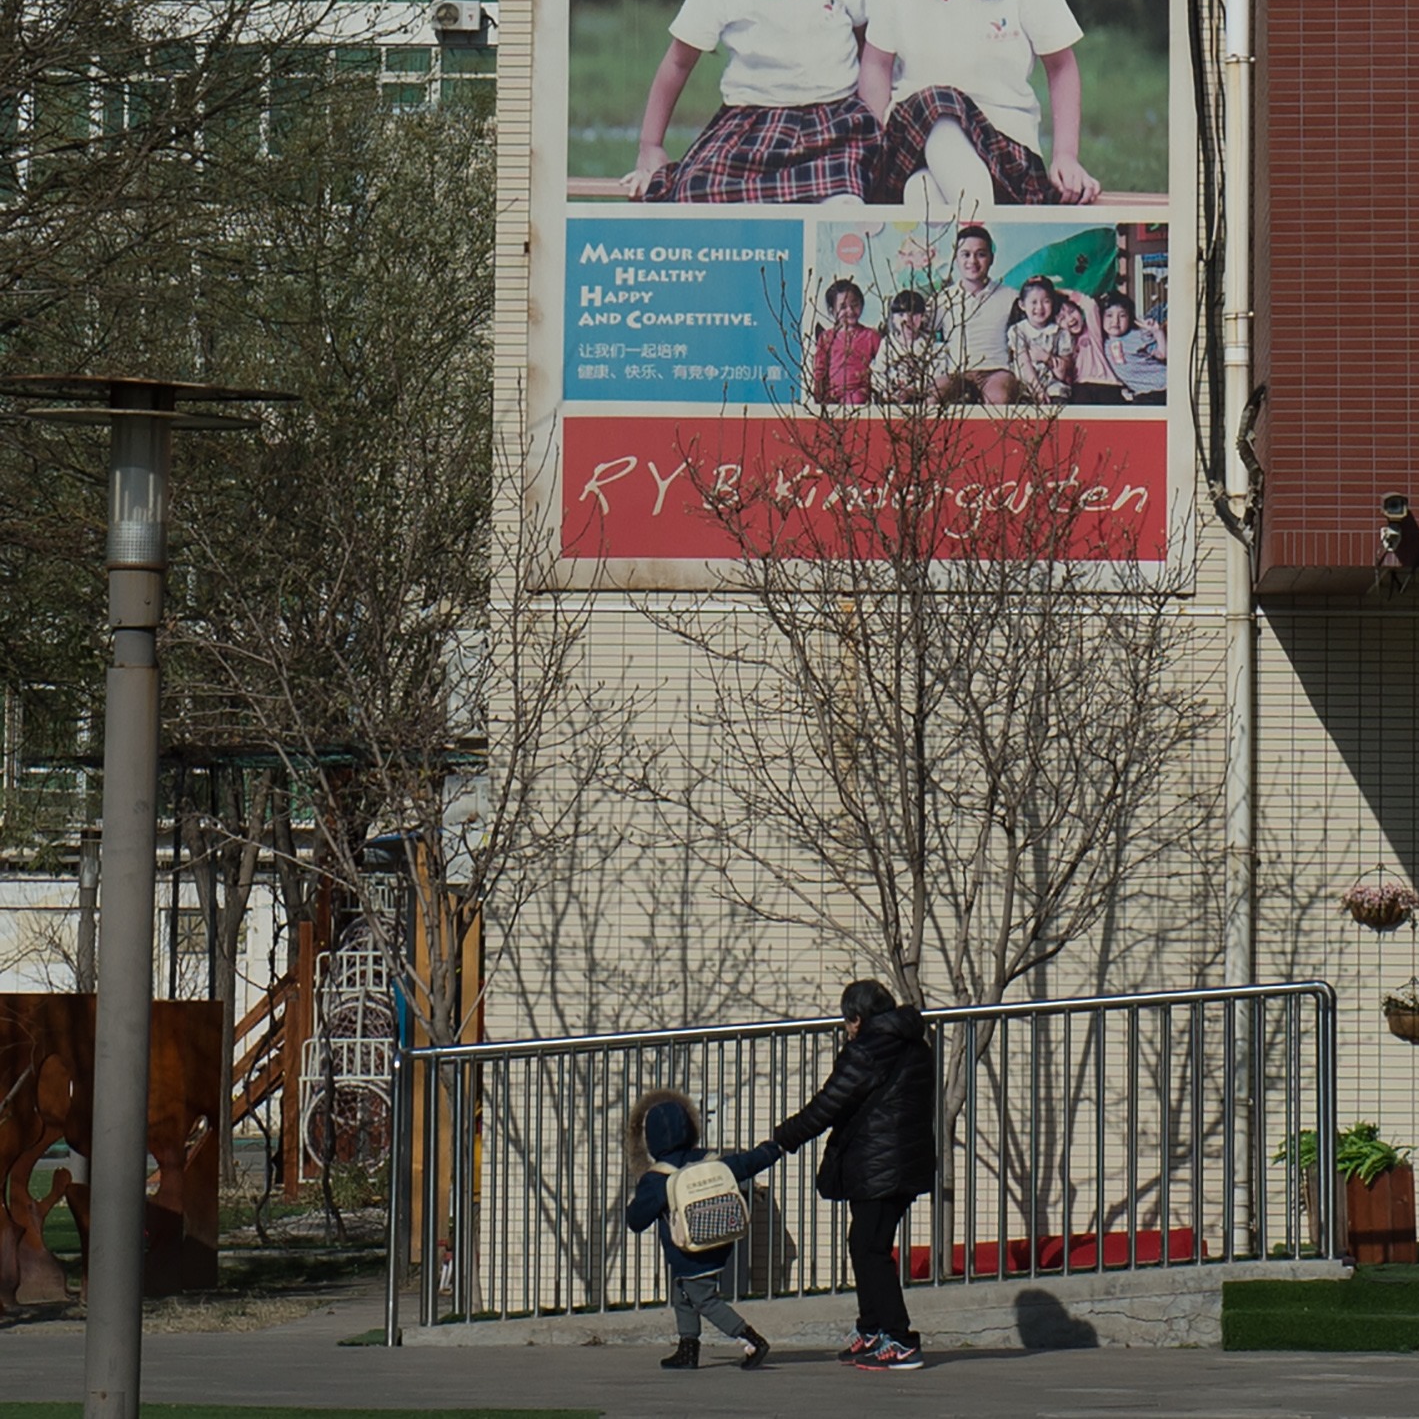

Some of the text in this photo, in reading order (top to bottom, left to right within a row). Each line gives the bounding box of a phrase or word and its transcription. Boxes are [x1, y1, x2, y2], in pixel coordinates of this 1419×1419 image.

[578, 343, 688, 360] 让我们一起培养
